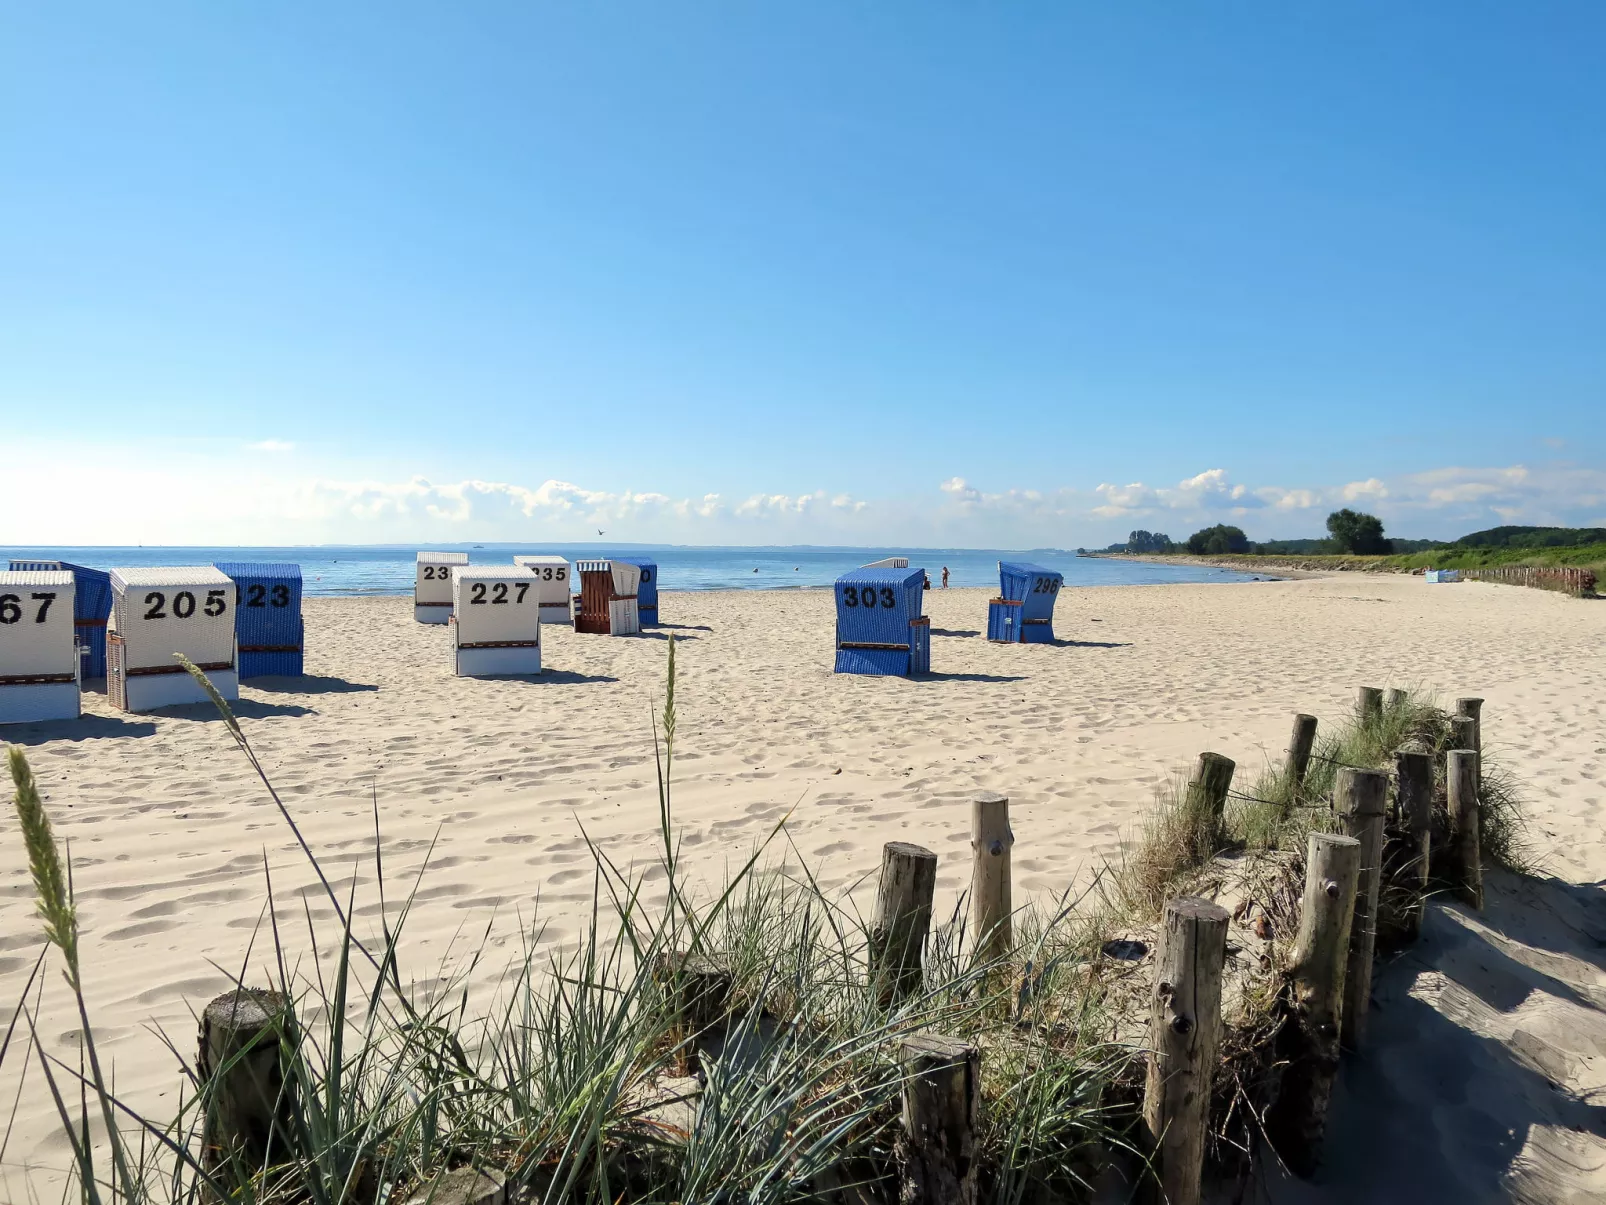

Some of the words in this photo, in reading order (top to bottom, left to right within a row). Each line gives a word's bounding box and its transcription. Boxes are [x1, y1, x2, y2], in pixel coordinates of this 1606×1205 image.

[424, 566, 453, 580] 23
[471, 583, 530, 604] 227
[1033, 577, 1059, 594] 296
[144, 590, 226, 620] 205
[843, 586, 896, 608] 303
[0, 593, 56, 624] 67
